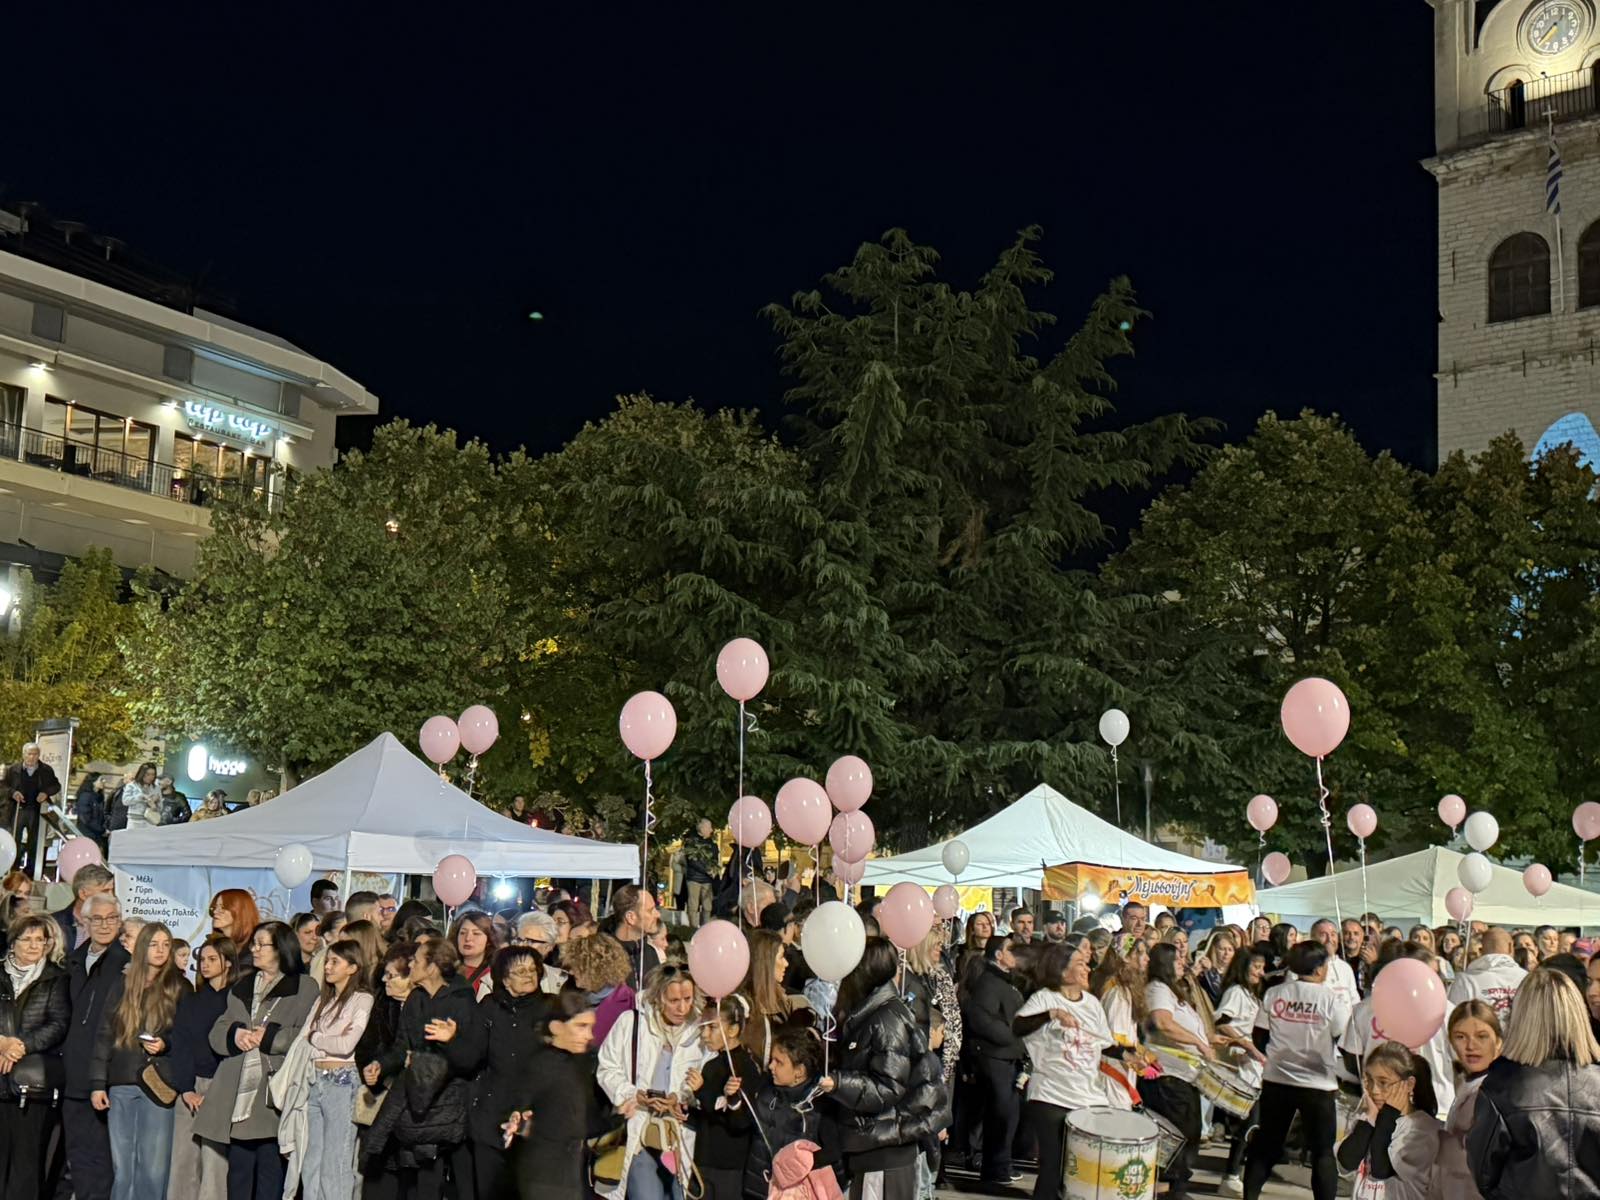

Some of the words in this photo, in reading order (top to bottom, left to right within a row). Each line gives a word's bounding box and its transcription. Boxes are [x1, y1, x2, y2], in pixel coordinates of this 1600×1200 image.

[1551, 7, 1559, 16] 12
[208, 755, 247, 776] hygge
[135, 875, 153, 883] Μέλι
[132, 907, 170, 916] Βασιλικός
